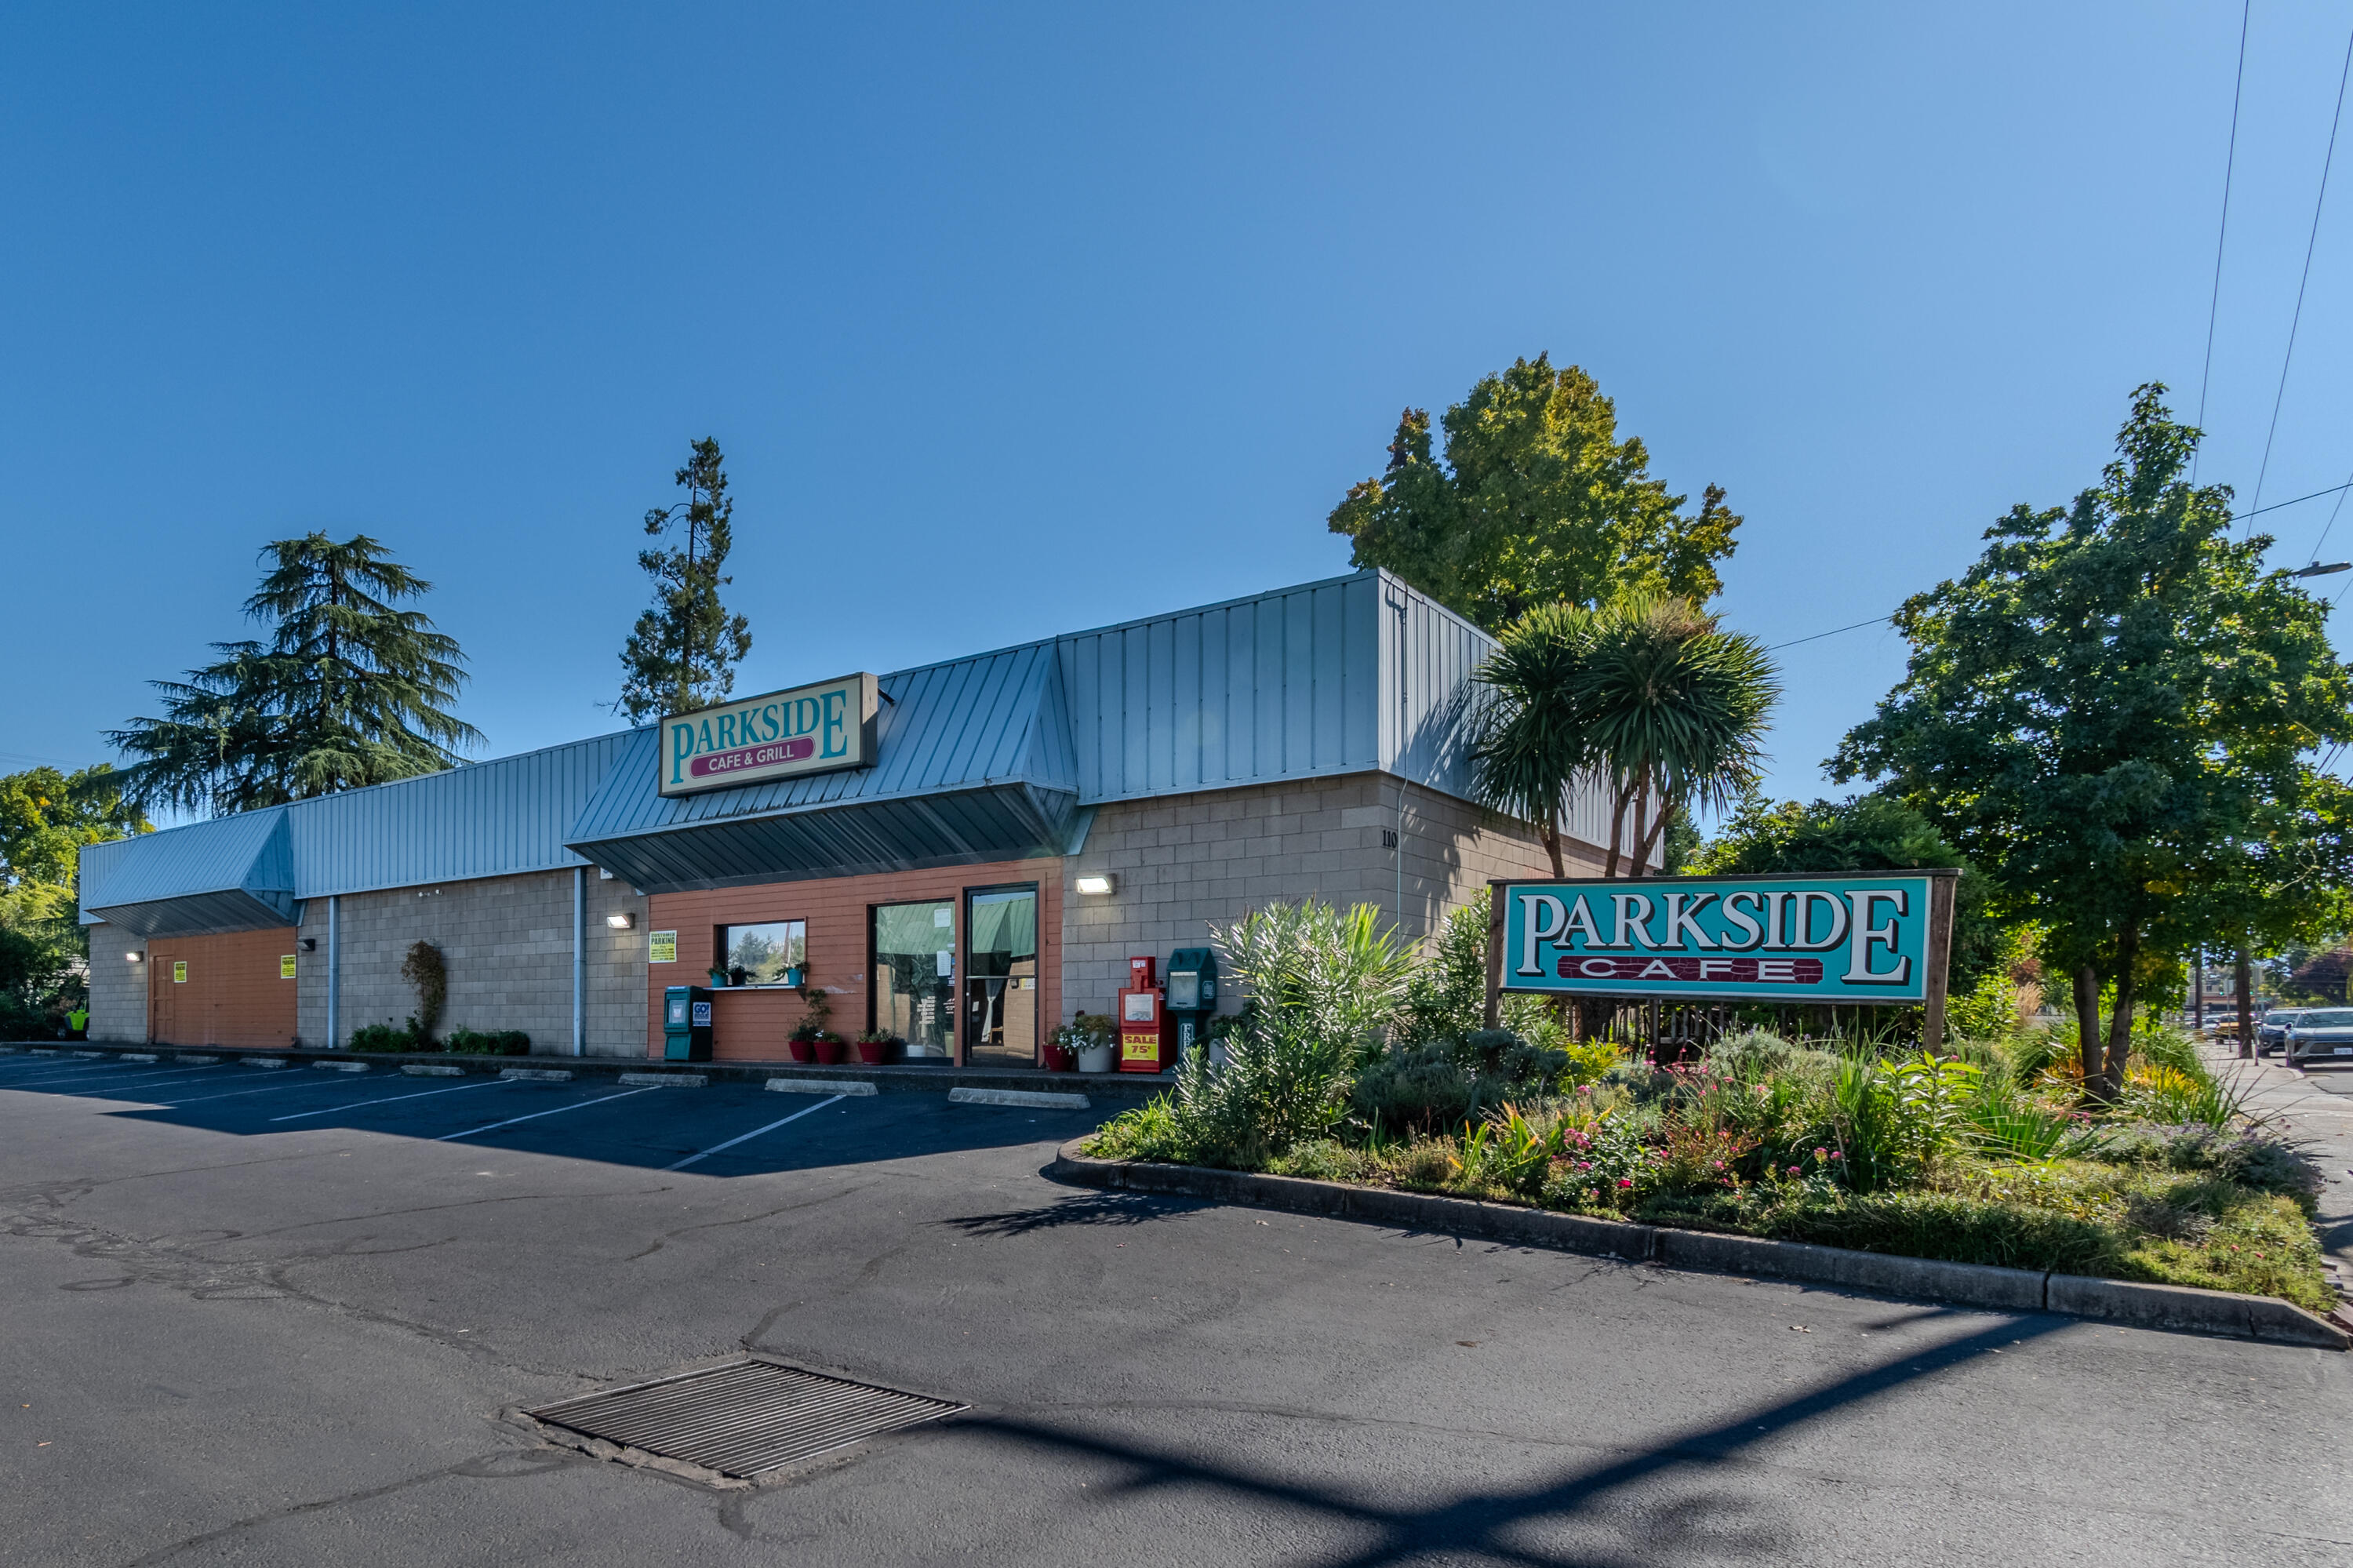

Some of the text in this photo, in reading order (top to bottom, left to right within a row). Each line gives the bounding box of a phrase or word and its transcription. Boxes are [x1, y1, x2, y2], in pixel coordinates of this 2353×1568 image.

[670, 689, 848, 784] PARKSIDE
[709, 744, 795, 772] CAFE & GRILL
[1382, 830, 1398, 849] 110
[1515, 889, 1912, 986] PARKSIDE
[1579, 958, 1796, 981] CAFE
[694, 1004, 710, 1013] GO!
